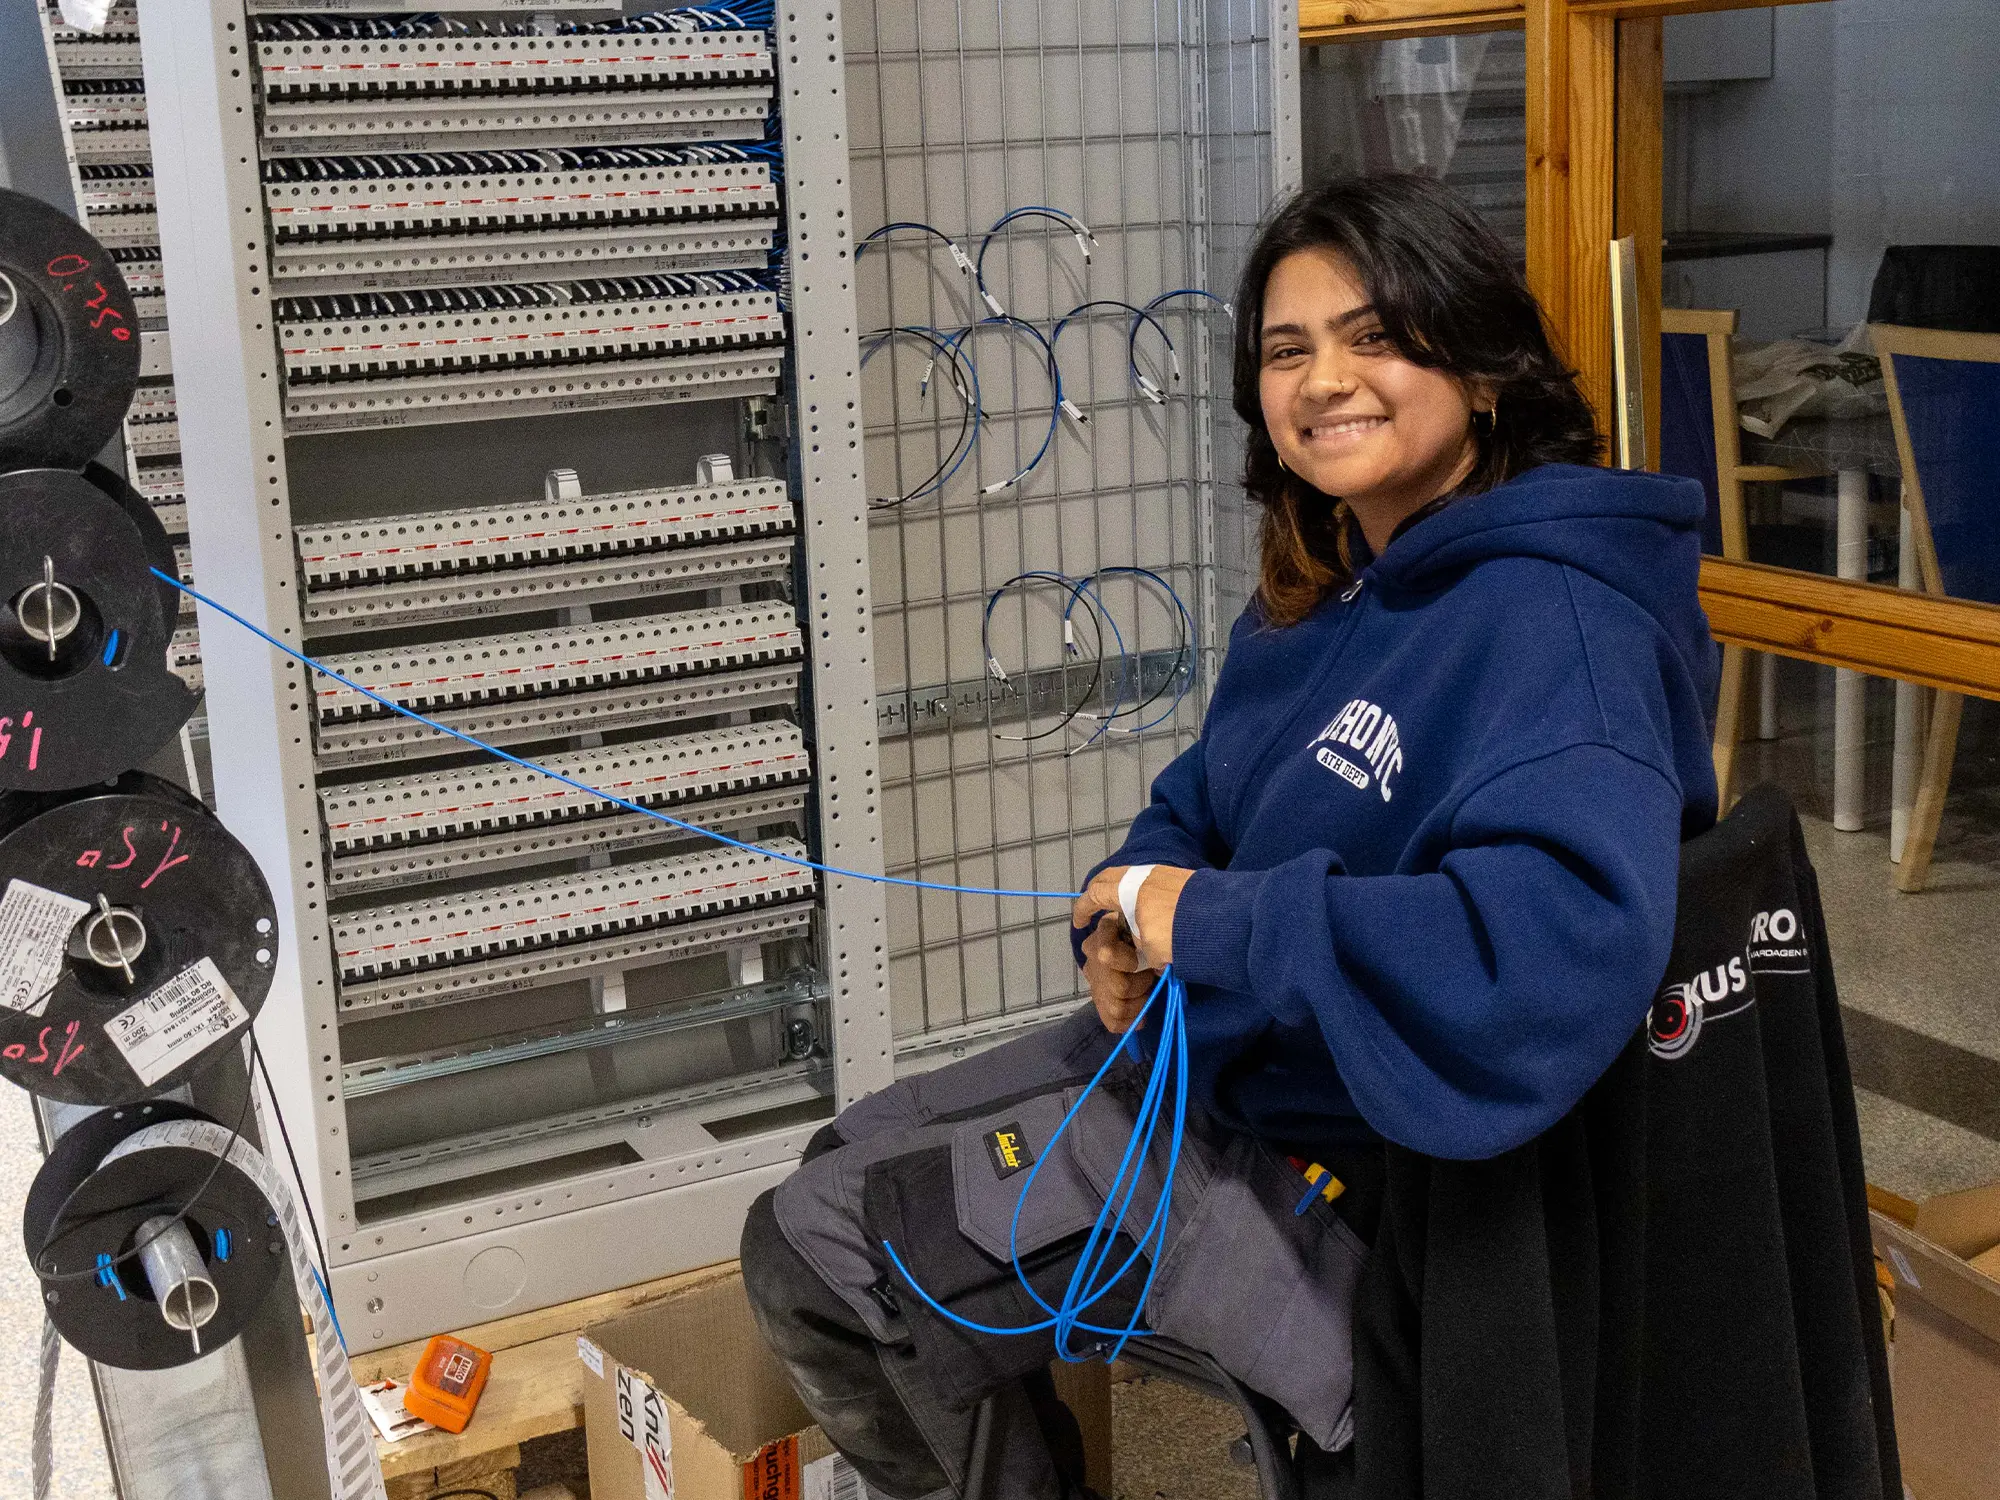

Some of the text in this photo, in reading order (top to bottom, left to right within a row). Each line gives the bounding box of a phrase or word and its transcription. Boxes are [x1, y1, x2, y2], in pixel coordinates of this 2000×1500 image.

[1321, 752, 1365, 785] ATH DEPT
[1751, 909, 1796, 943] RO
